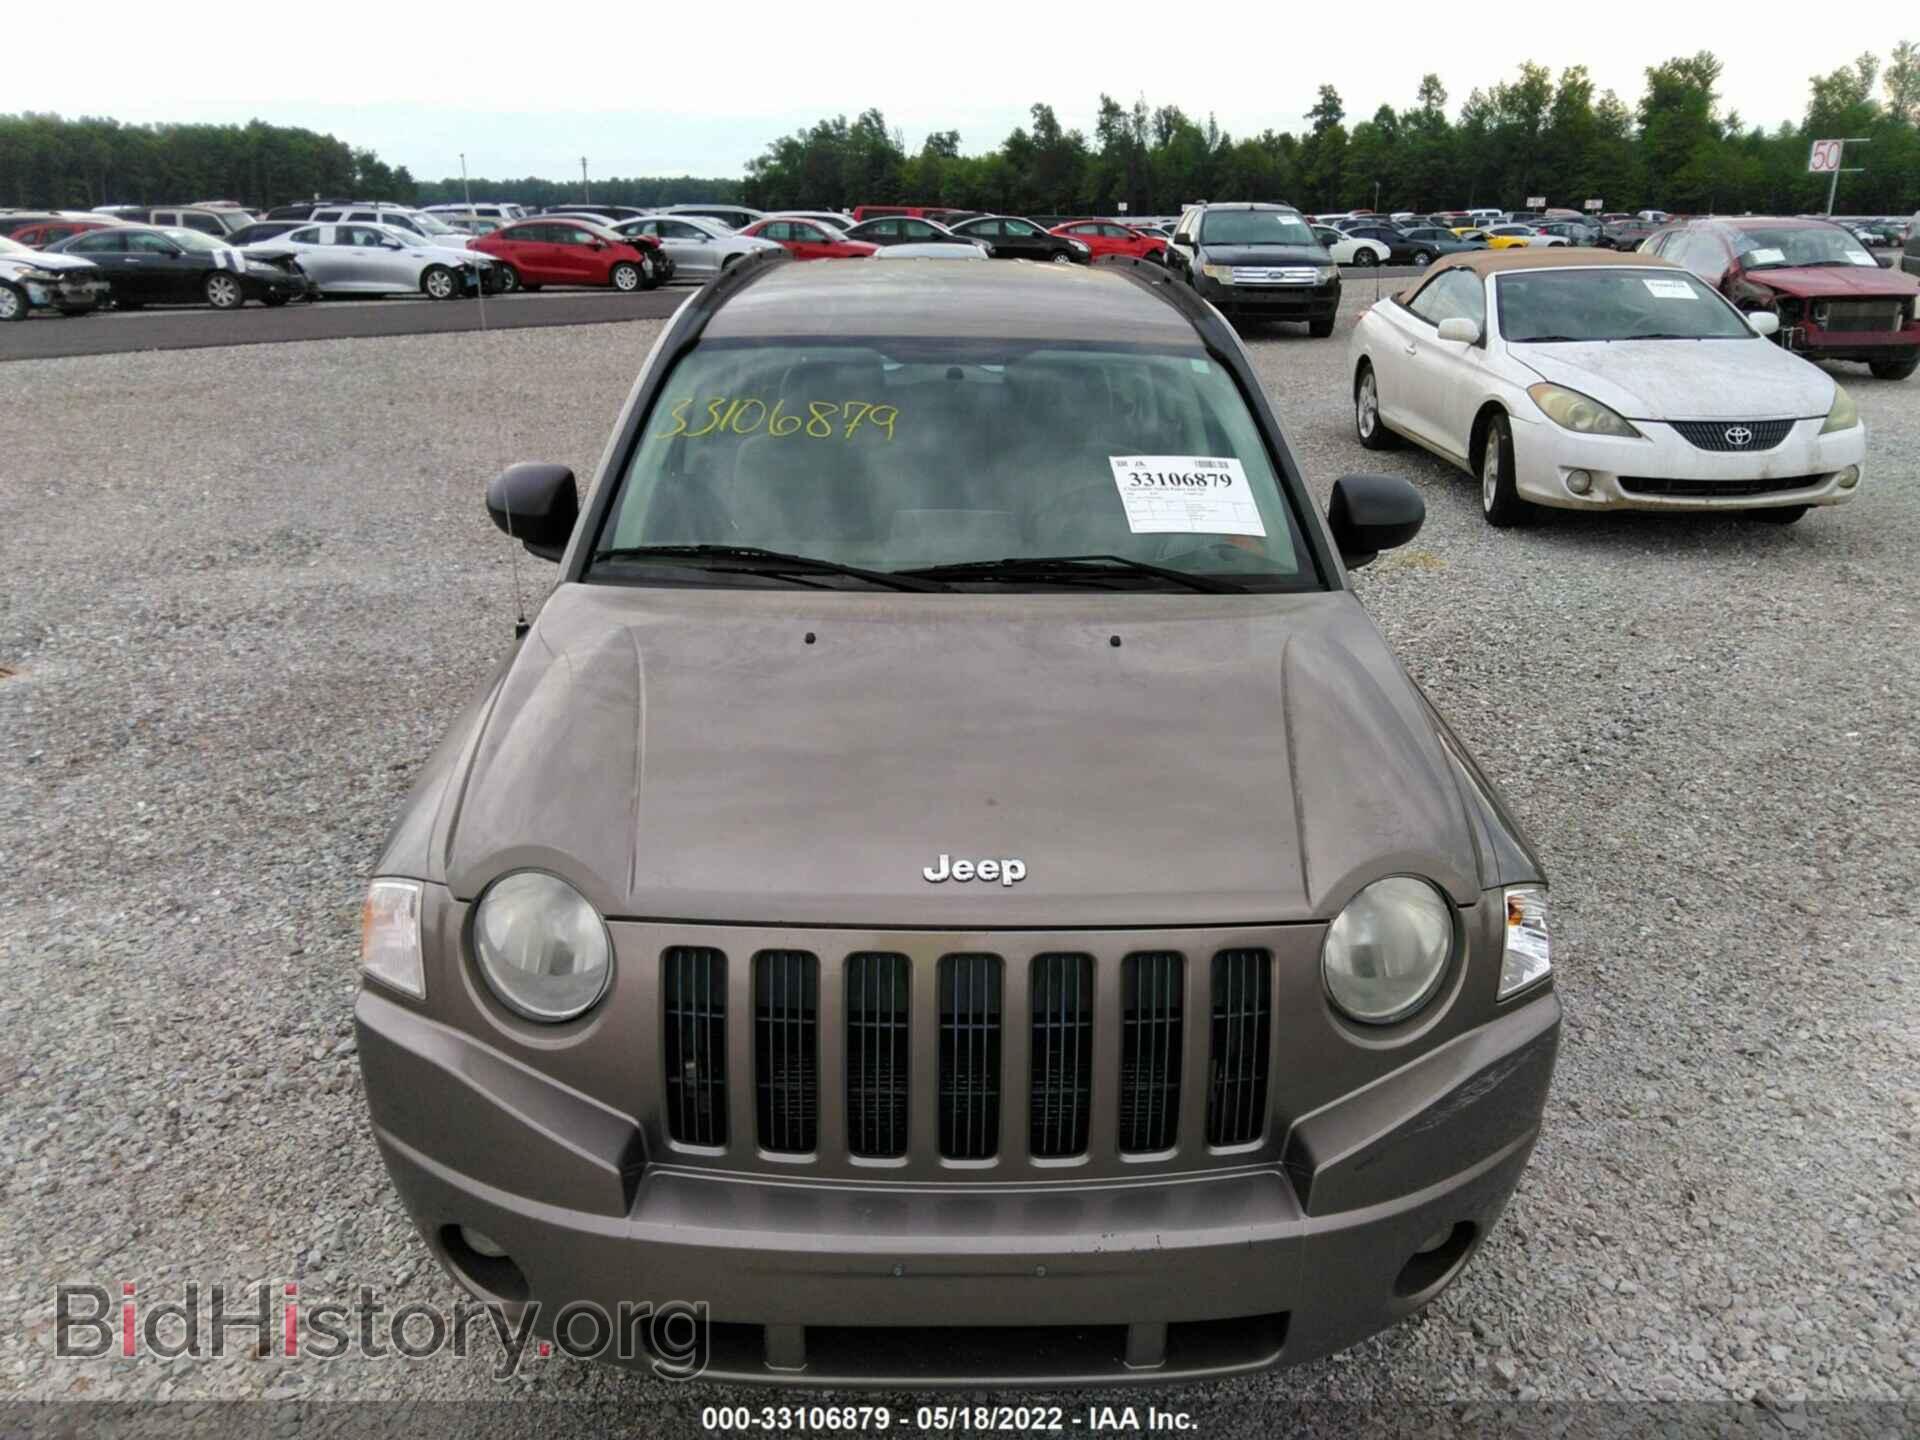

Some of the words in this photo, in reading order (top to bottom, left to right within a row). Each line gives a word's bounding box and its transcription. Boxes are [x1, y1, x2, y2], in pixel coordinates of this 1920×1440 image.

[1812, 141, 1841, 170] 50
[656, 396, 900, 441] 33106879
[1128, 471, 1233, 488] 33106879
[922, 853, 1027, 887] Jeep
